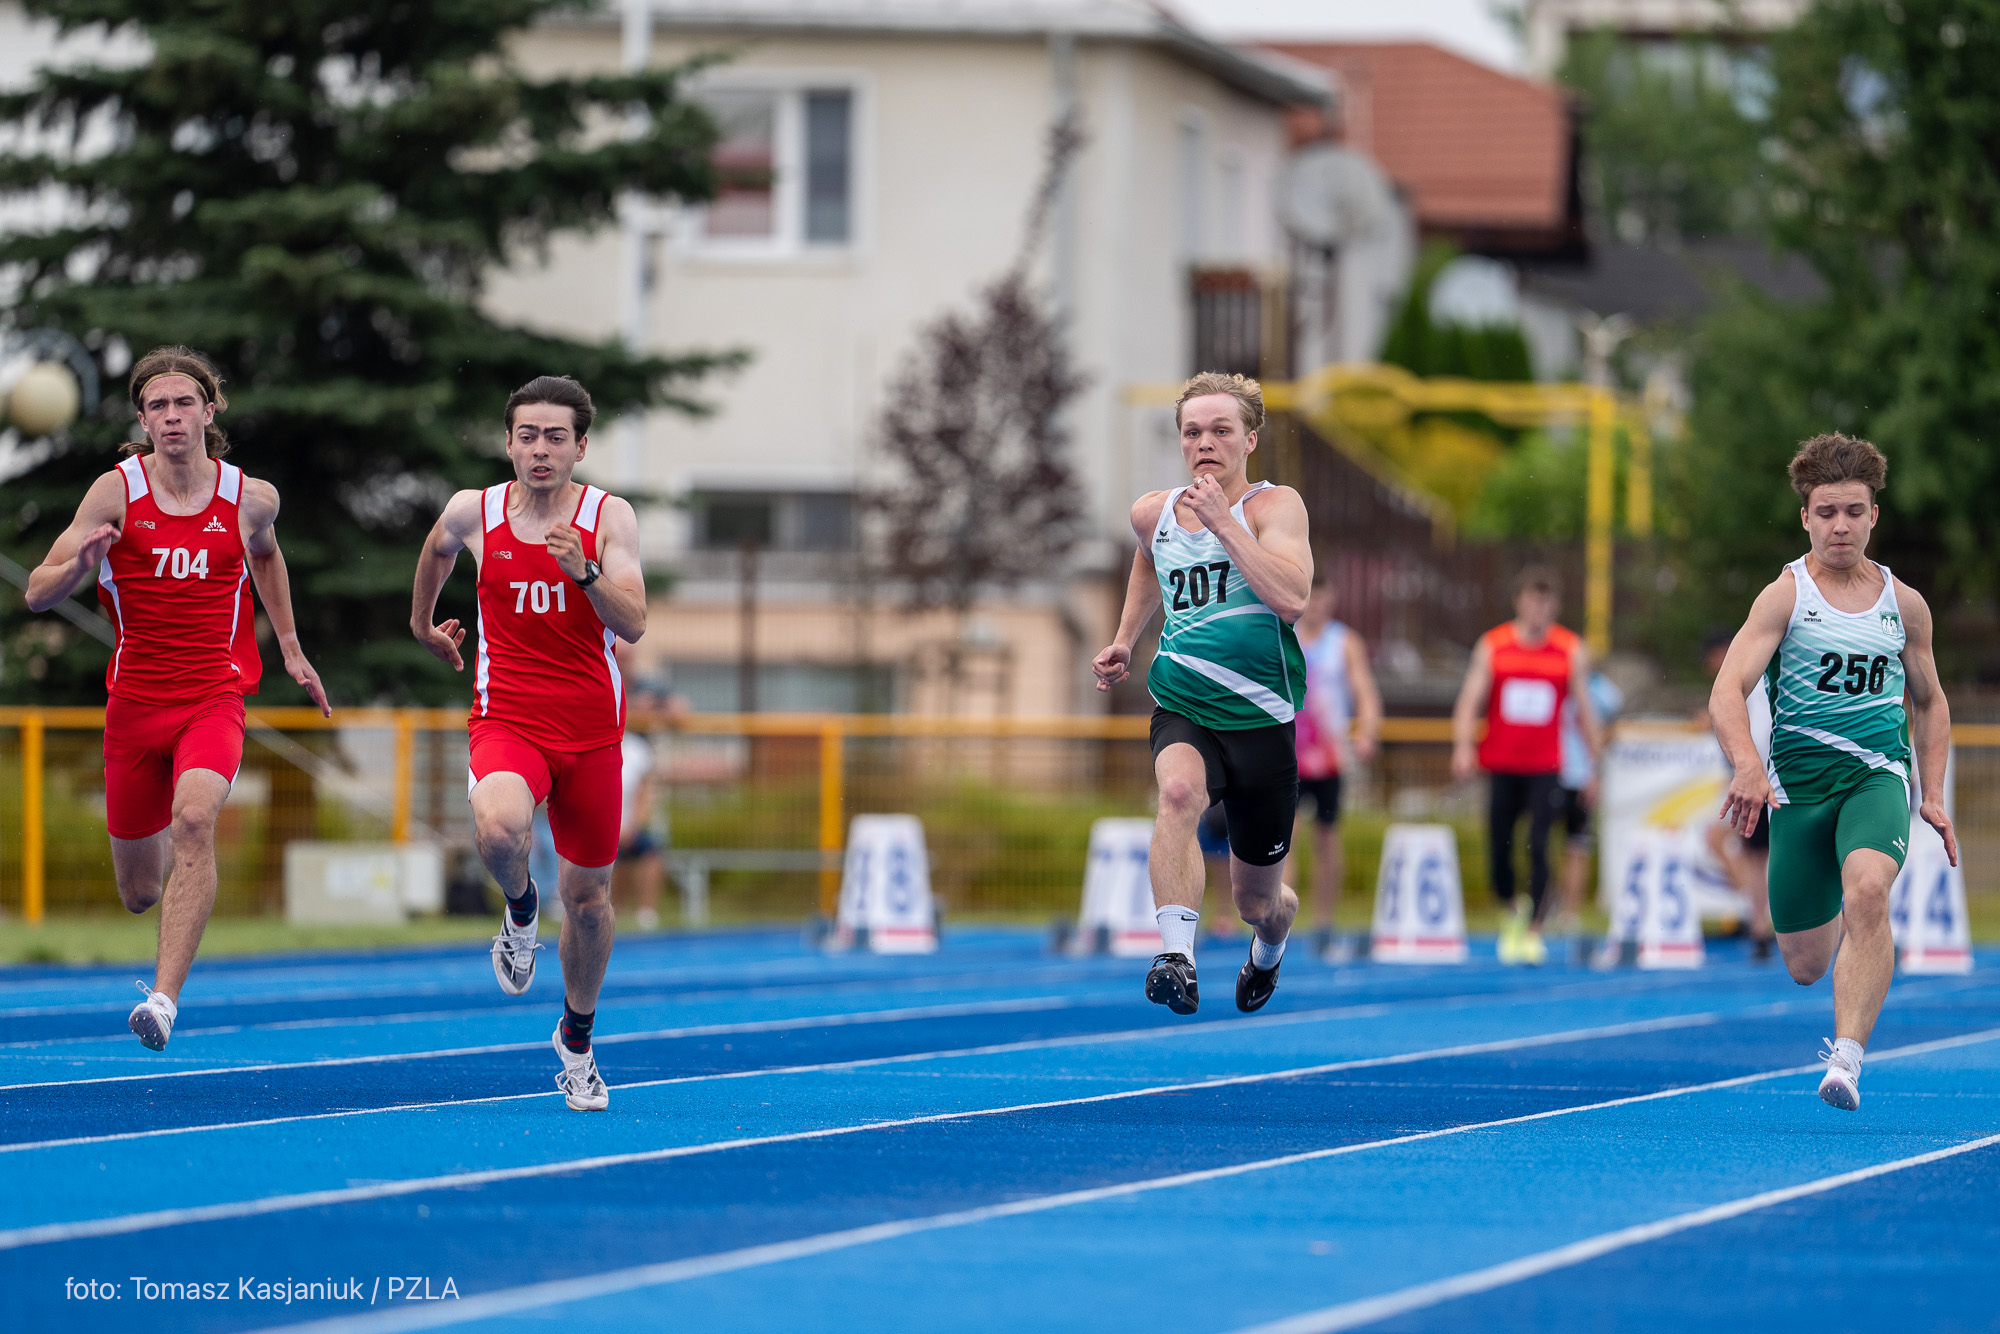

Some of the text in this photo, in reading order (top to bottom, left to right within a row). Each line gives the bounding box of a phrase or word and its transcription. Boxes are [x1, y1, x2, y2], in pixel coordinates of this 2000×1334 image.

[152, 547, 209, 579] 704
[1169, 561, 1230, 611] 207
[509, 580, 566, 613] 701
[1817, 652, 1888, 695] 256
[1415, 853, 1449, 930] 6
[1658, 855, 1688, 932] 5
[1924, 868, 1954, 935] 4
